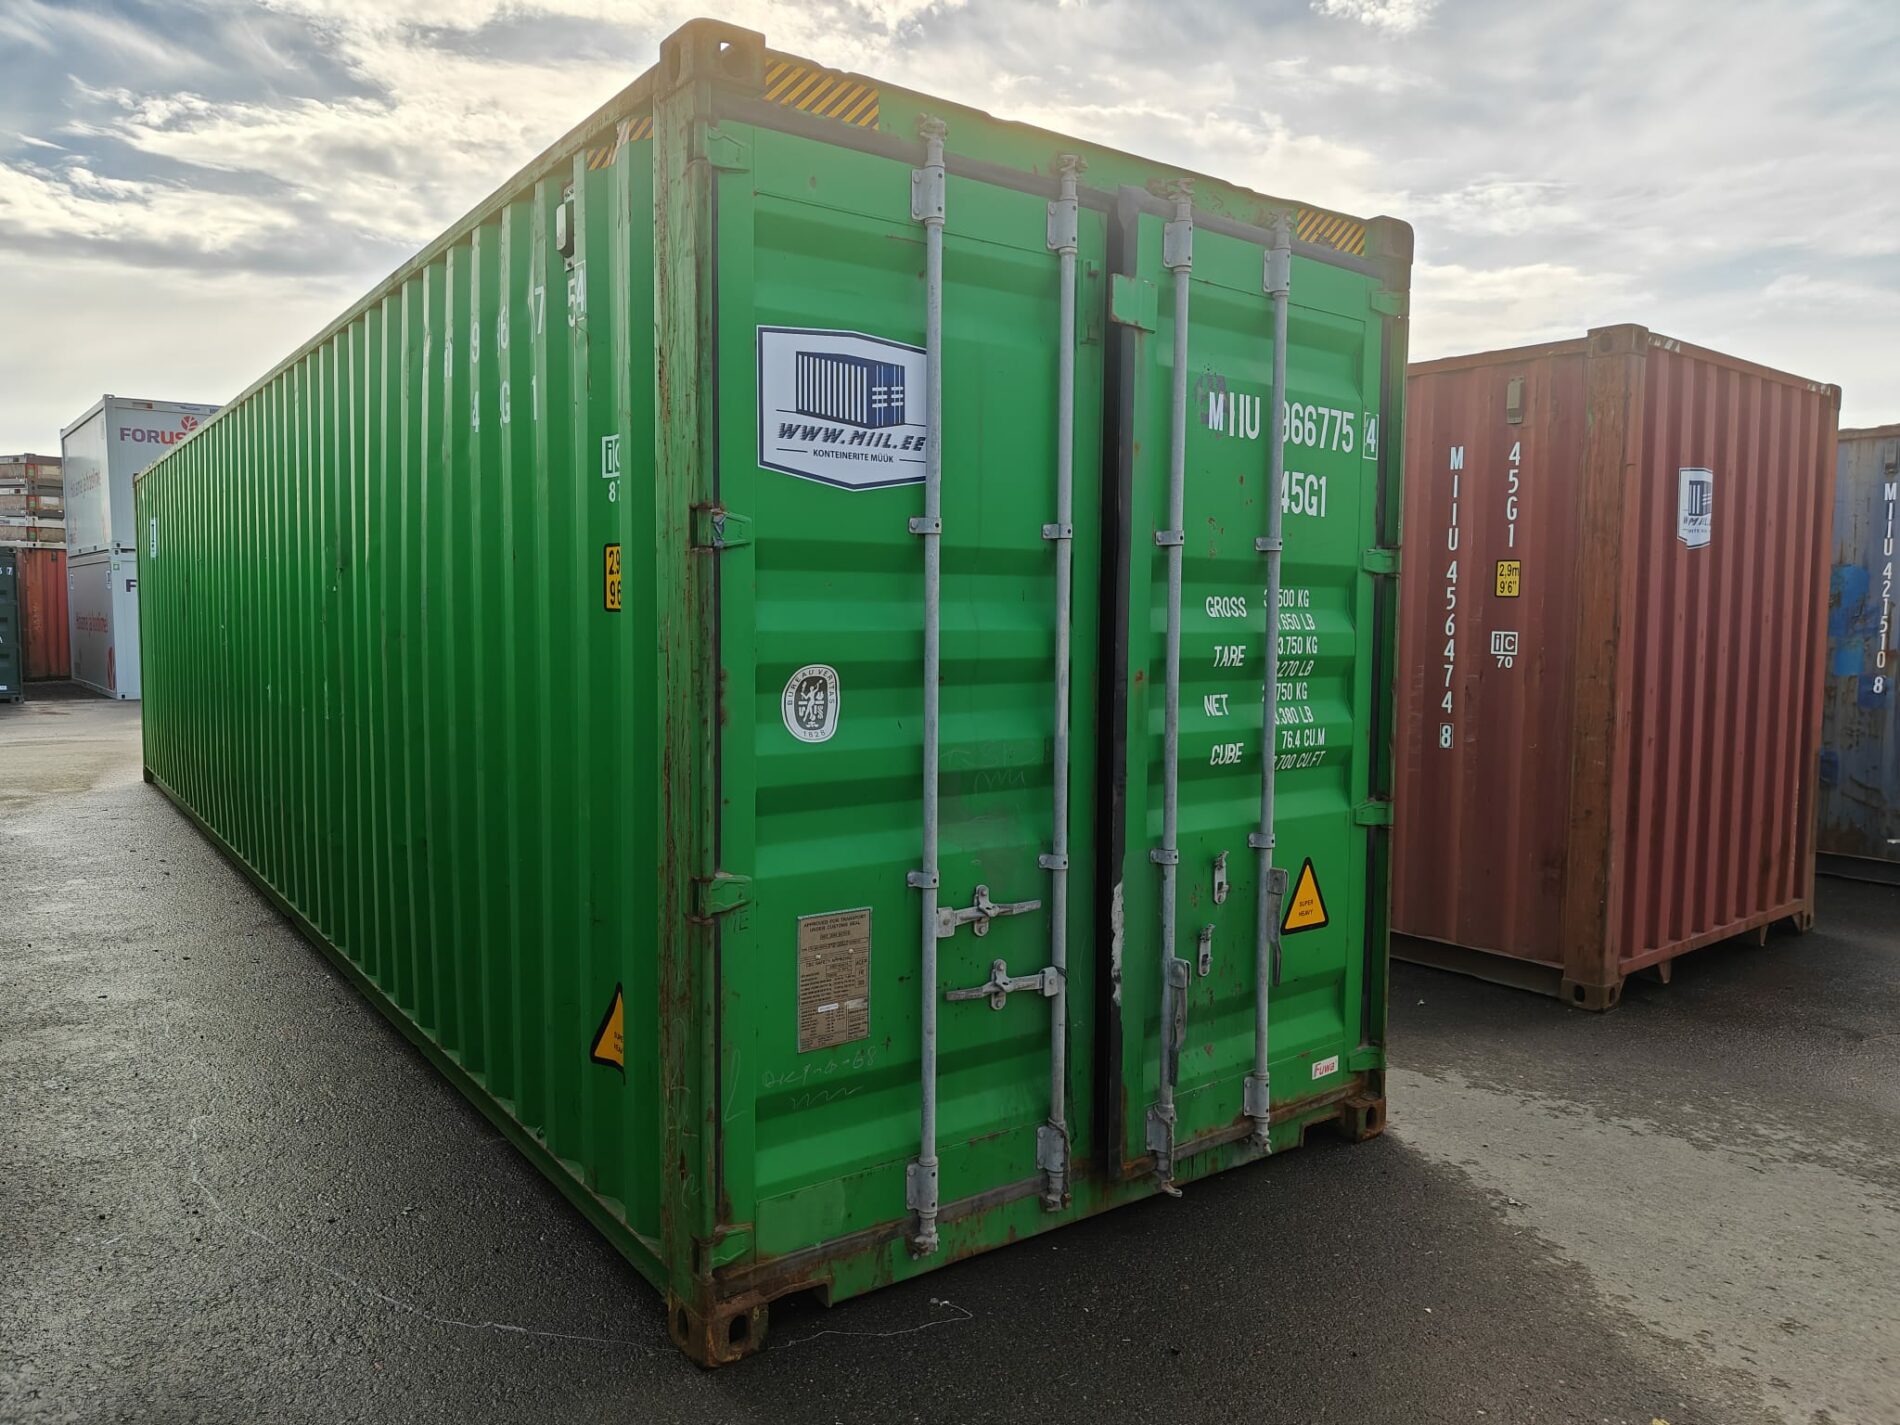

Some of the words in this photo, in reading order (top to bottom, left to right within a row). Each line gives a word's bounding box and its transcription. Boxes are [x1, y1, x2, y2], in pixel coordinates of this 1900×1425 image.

[777, 422, 927, 451] WWW.MIIL.EE
[1208, 391, 1260, 440] MIIU
[1366, 418, 1376, 453] 4
[813, 449, 869, 461] KONTEINERITE
[871, 453, 894, 463] MÜÜK
[1448, 446, 1464, 550] MIIU
[1506, 441, 1520, 548] 45G1
[1883, 483, 1897, 556] MIIU
[1206, 596, 1247, 617] GROSS
[1298, 589, 1309, 607] KG
[1876, 562, 1892, 668] 421510
[1301, 614, 1315, 630] LB
[1441, 560, 1458, 714] 456474
[1214, 645, 1246, 667] TARE
[1306, 636, 1318, 654] KG
[1496, 656, 1513, 669] 70
[1299, 660, 1314, 676] LB
[1204, 693, 1229, 717] NET
[1296, 683, 1308, 700] KG
[1873, 676, 1883, 694] 8
[1301, 706, 1314, 723] LB
[1210, 742, 1244, 766] CUBE
[1282, 730, 1300, 749] 76.4
[1440, 725, 1452, 747] 8
